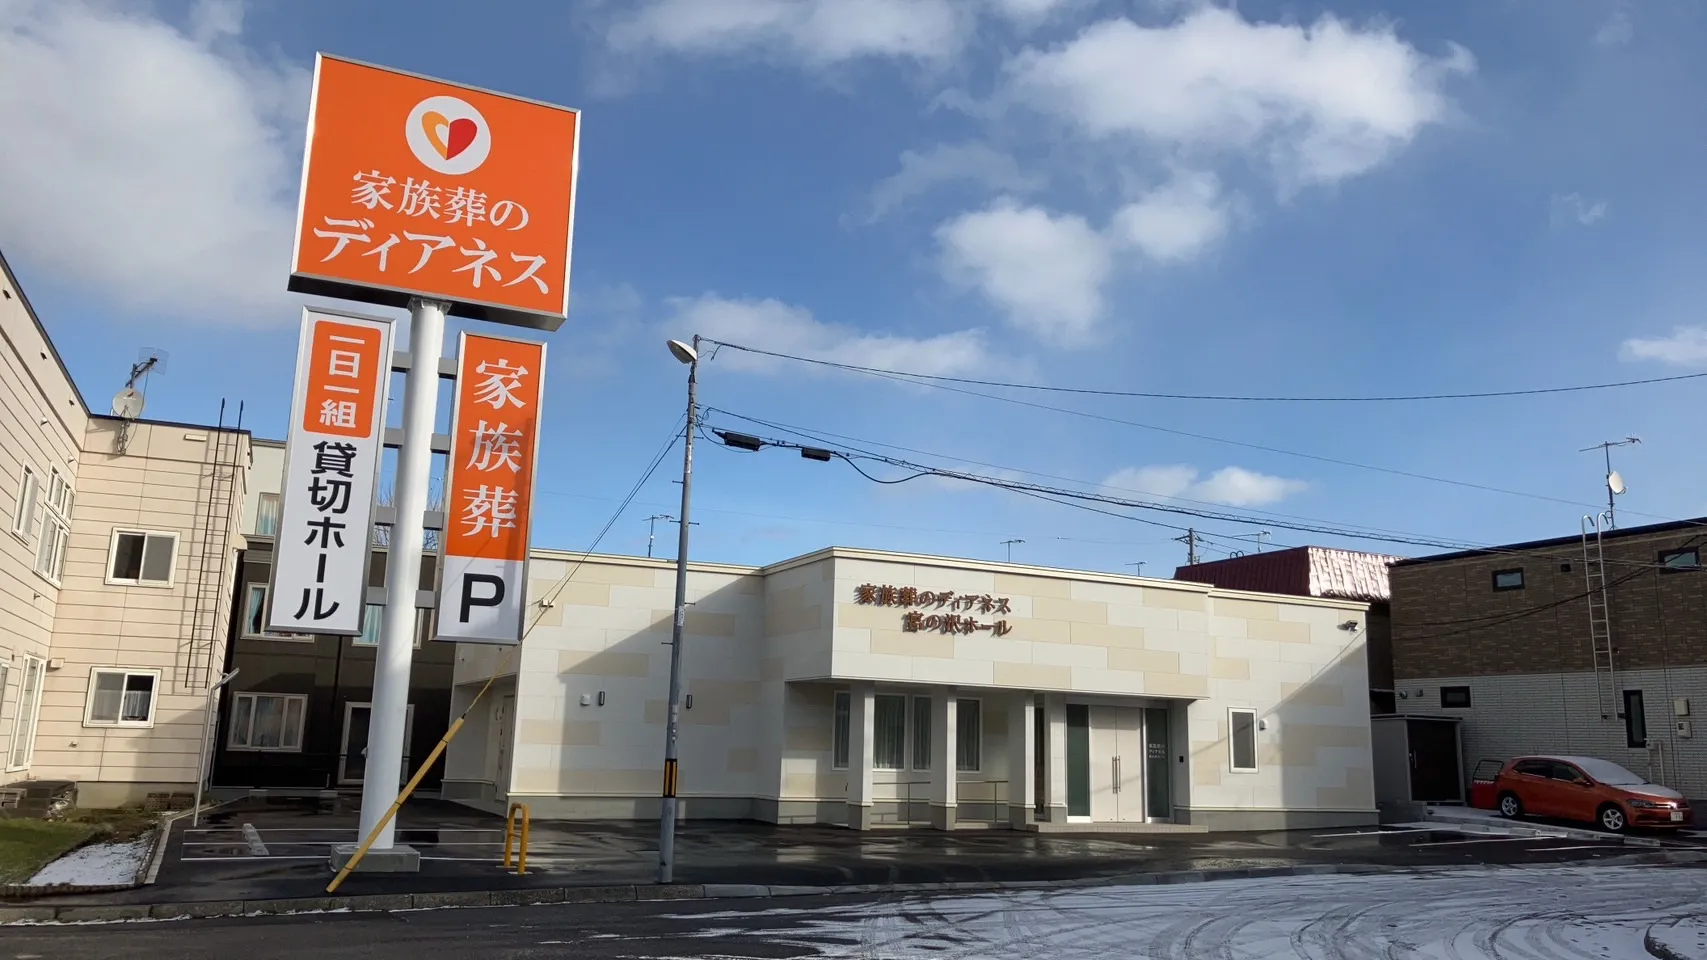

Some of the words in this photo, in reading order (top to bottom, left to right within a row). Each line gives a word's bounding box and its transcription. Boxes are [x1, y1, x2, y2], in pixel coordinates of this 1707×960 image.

[351, 169, 529, 231] 家族葬の
[313, 215, 549, 295] ディアネス
[319, 335, 365, 429] 一日一組
[460, 358, 529, 538] 家族葬
[294, 440, 357, 620] 貸切ホール
[459, 572, 506, 623] P
[857, 583, 1011, 614] 家族葬のディアネス
